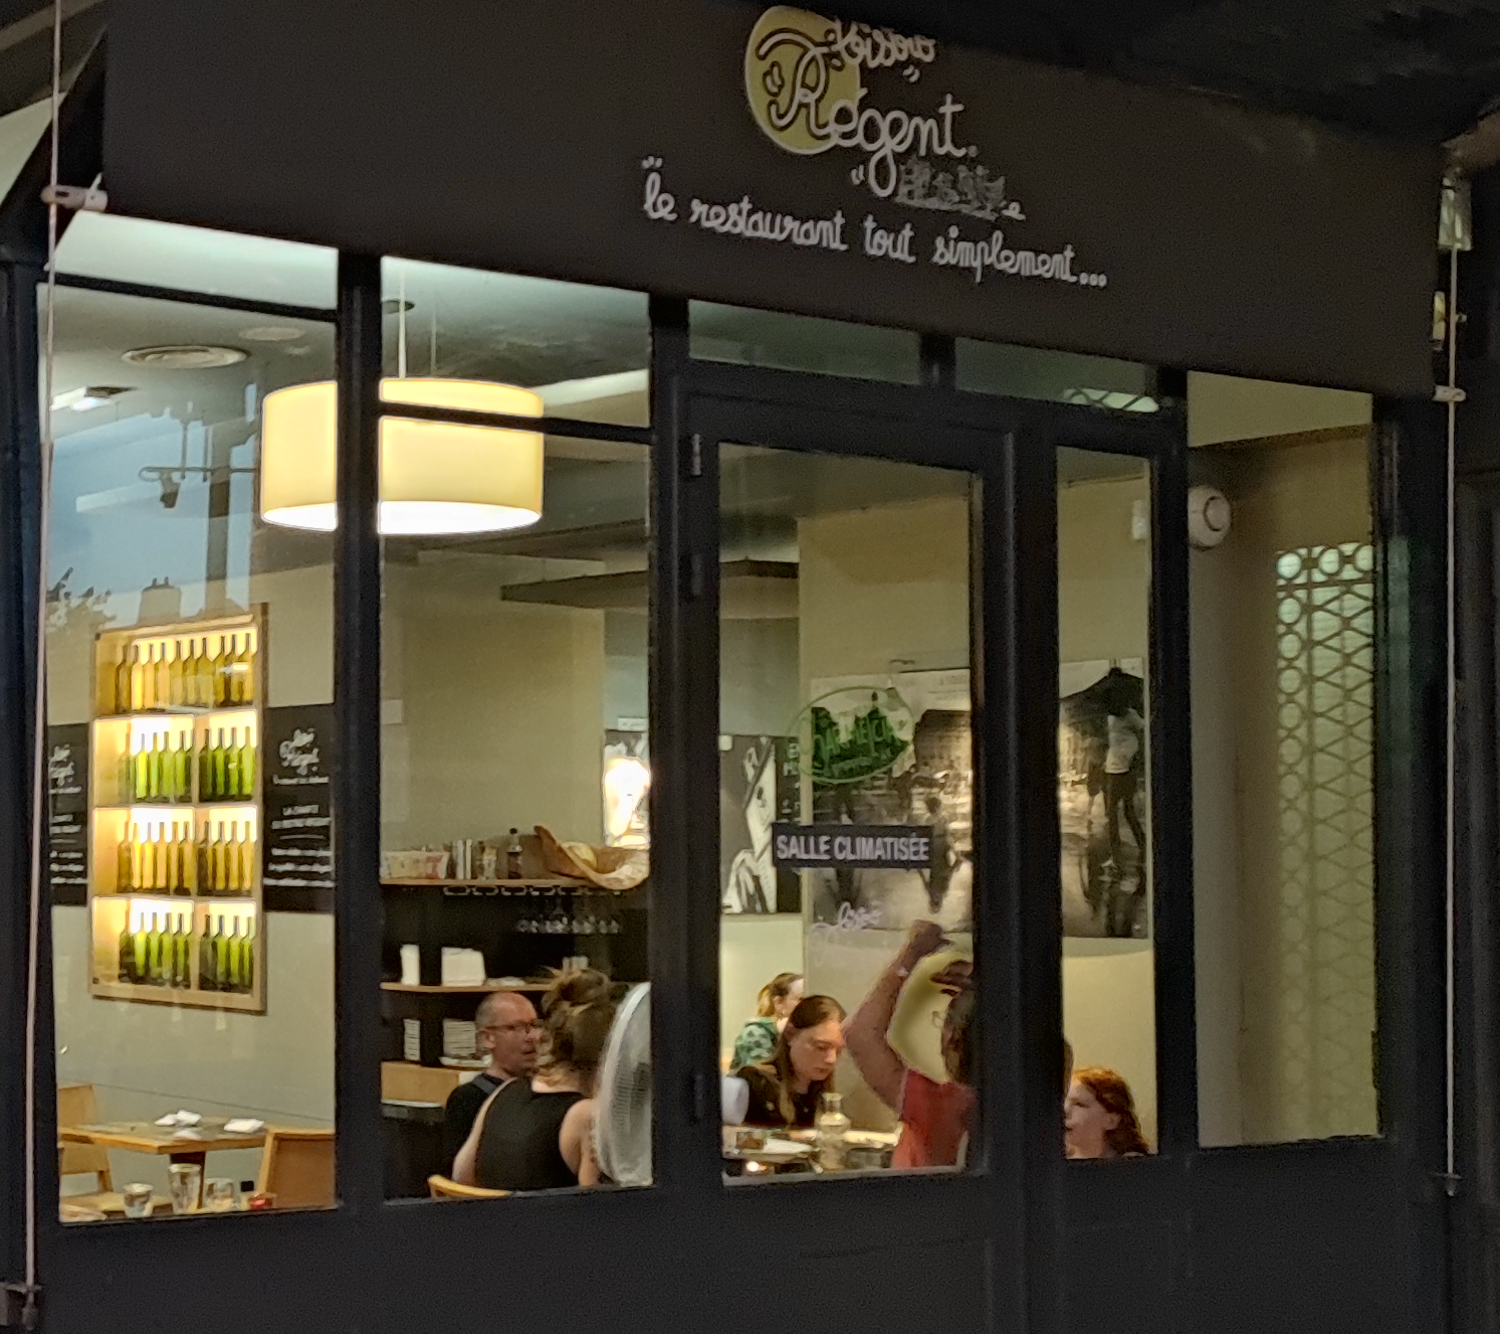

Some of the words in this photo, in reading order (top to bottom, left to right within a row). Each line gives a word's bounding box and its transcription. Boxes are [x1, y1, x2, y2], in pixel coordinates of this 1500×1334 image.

[643, 170, 677, 221] le
[690, 195, 848, 251] restaurant
[863, 214, 916, 263] tout
[776, 834, 832, 861] SALLE
[833, 831, 931, 862] CLIMATISÉE
